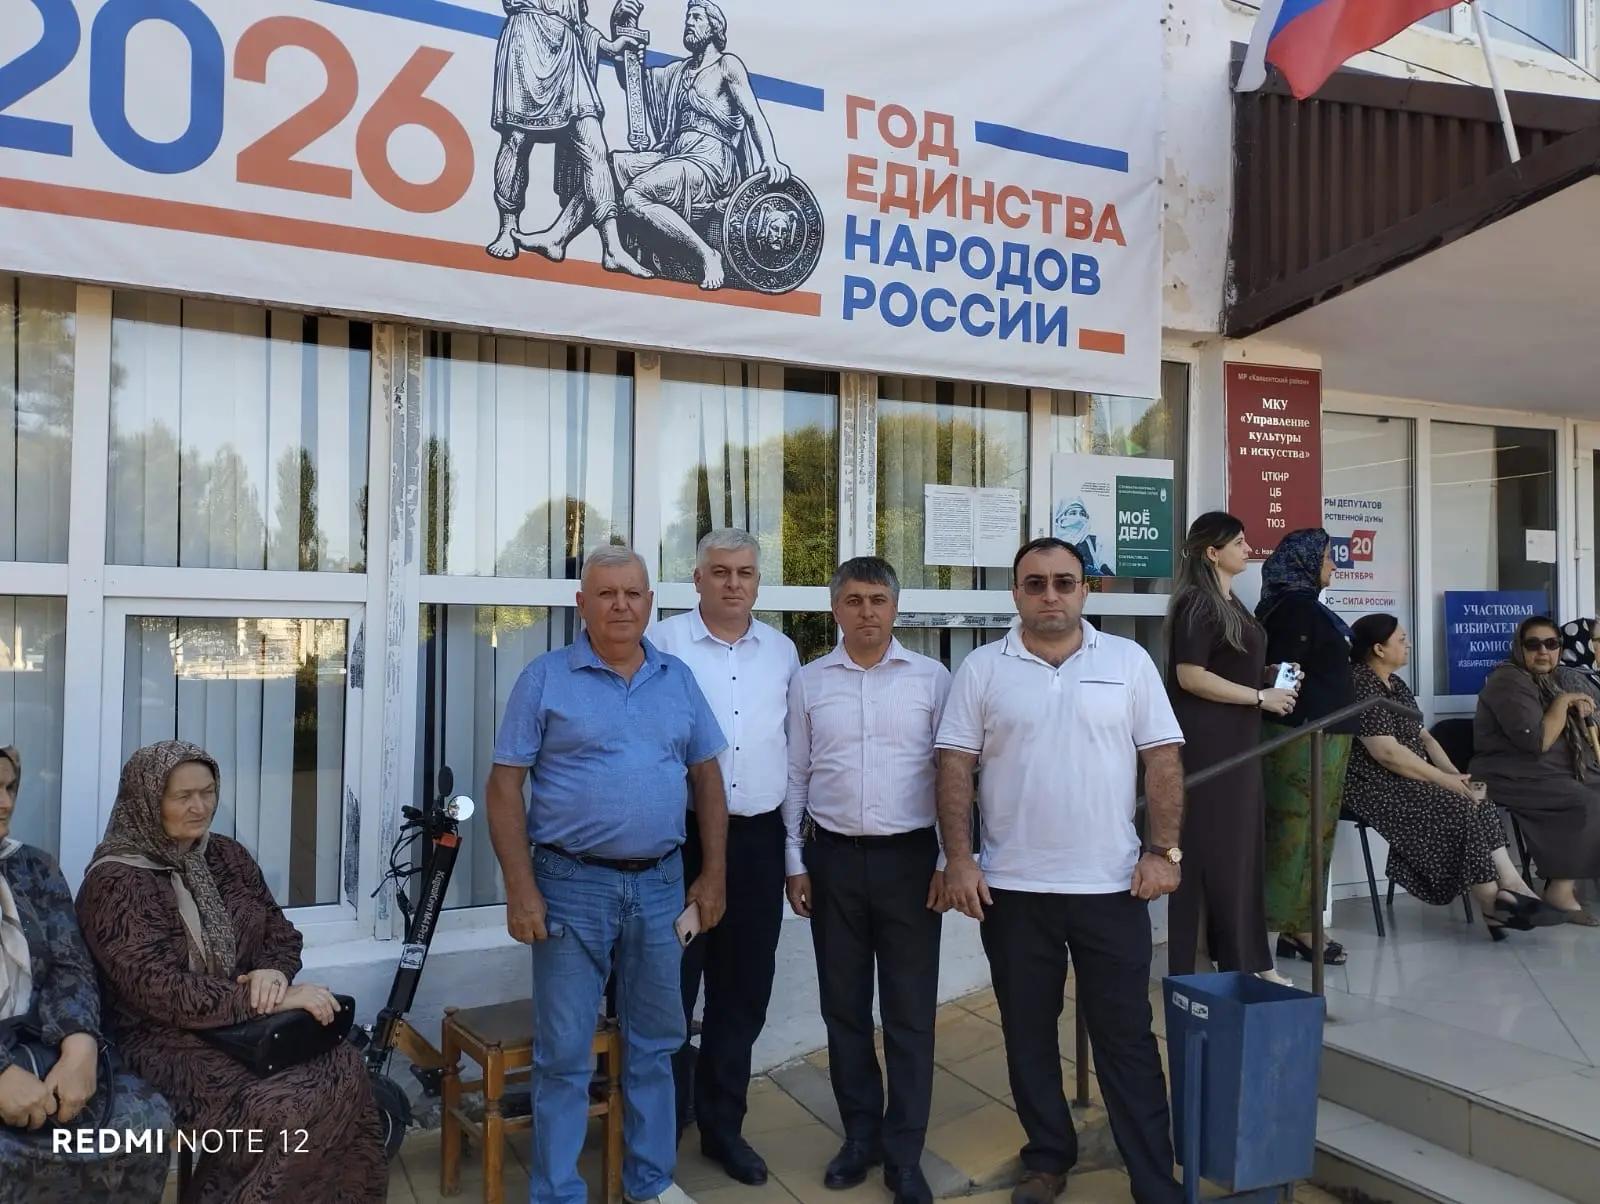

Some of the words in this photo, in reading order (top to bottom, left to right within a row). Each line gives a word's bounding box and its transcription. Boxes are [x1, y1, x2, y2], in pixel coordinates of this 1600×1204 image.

[0, 0, 475, 214] 2026
[846, 94, 959, 167] ГОД
[846, 153, 1127, 247] ЕДИНСТВА
[844, 214, 1101, 295] НАРОДОВ
[842, 274, 1068, 347] РОССИИ
[1262, 398, 1288, 411] МКУ
[1240, 412, 1310, 428] «Управление
[1249, 431, 1301, 444] культуры
[1240, 446, 1247, 455] и
[1251, 446, 1310, 460] искусства»
[1261, 471, 1290, 482] ЦТКНР
[1269, 488, 1282, 498] ЦБ
[1269, 503, 1282, 513] ДБ
[1337, 499, 1382, 509] ДЕПУТАТОВ
[1119, 509, 1151, 525] МОЁ
[1266, 518, 1286, 528] ТЮЗ
[1364, 515, 1384, 523] ДУМЫ
[1119, 526, 1159, 541] ДЕЛО
[1332, 545, 1349, 562] 19
[1352, 537, 1372, 555] 20
[1334, 571, 1374, 580] СЕНТЯБРЯ
[1342, 597, 1364, 605] СИЛА
[1463, 604, 1534, 616] УЧАСТКОВАЯ
